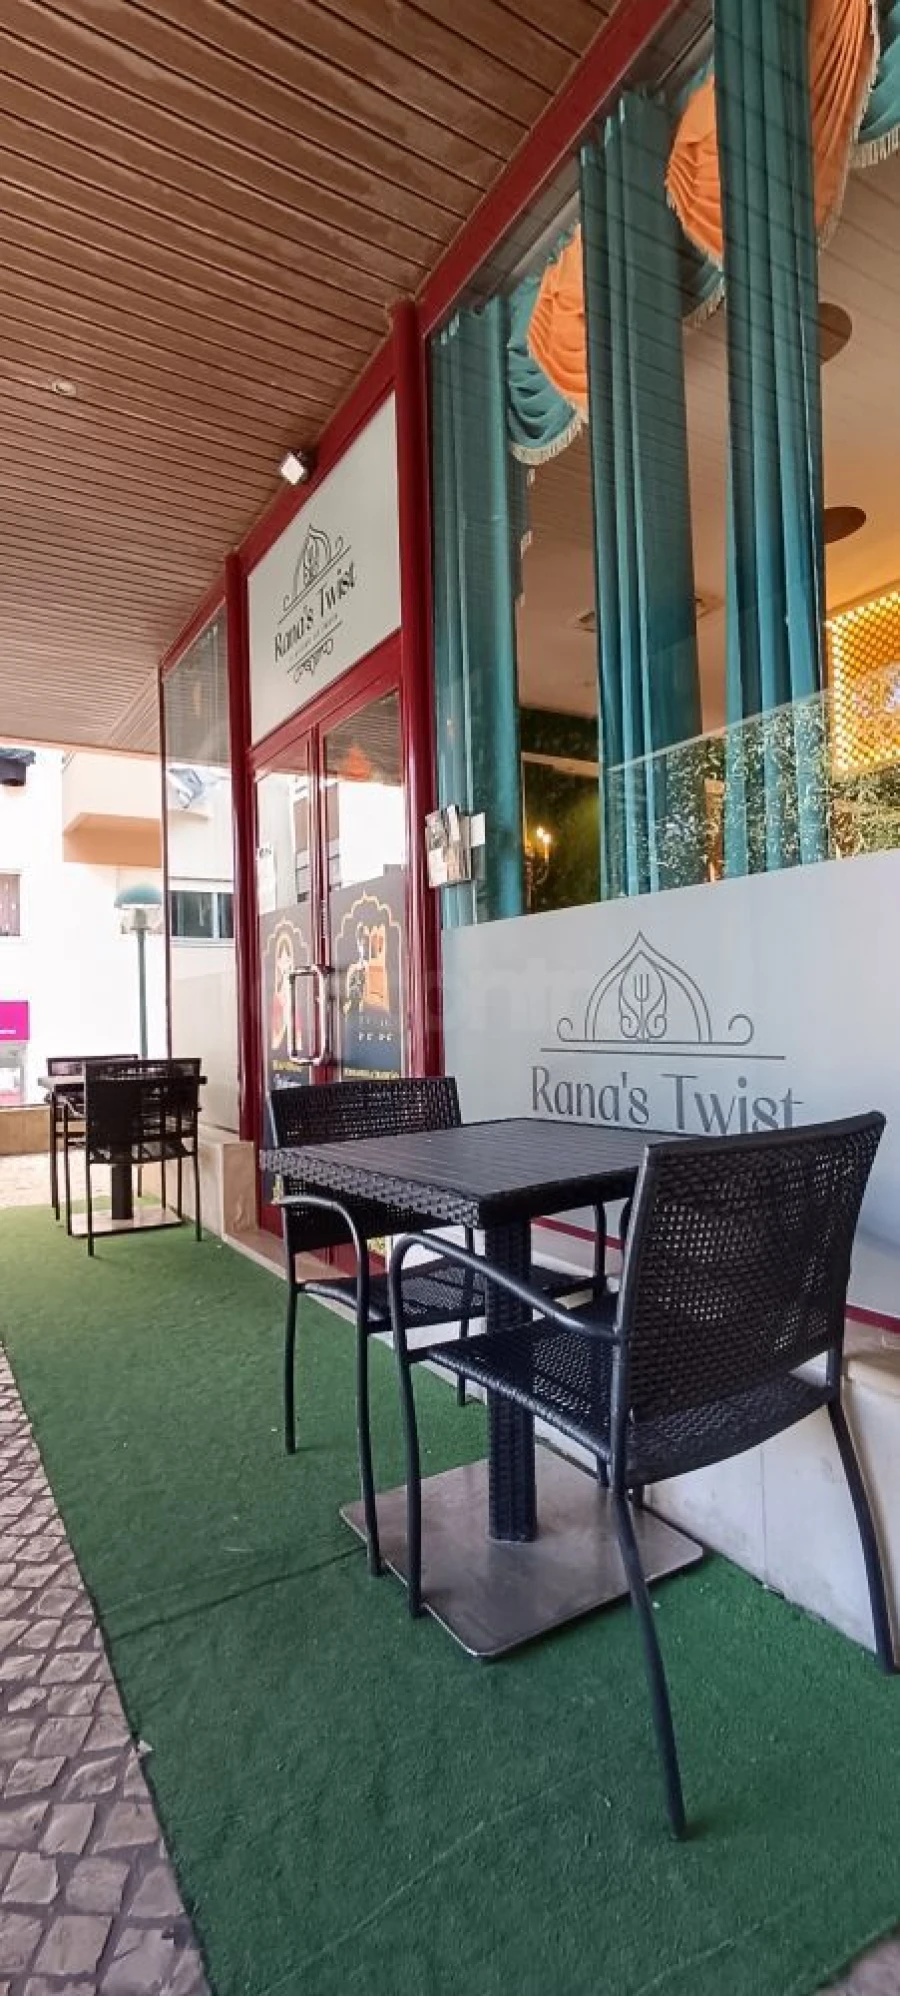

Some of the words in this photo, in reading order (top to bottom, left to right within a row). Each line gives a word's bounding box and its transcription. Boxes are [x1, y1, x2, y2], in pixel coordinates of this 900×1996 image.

[274, 604, 314, 663] Rana's
[317, 561, 356, 618] Twist
[531, 1065, 650, 1125] Rana's
[661, 1073, 804, 1137] Twist
